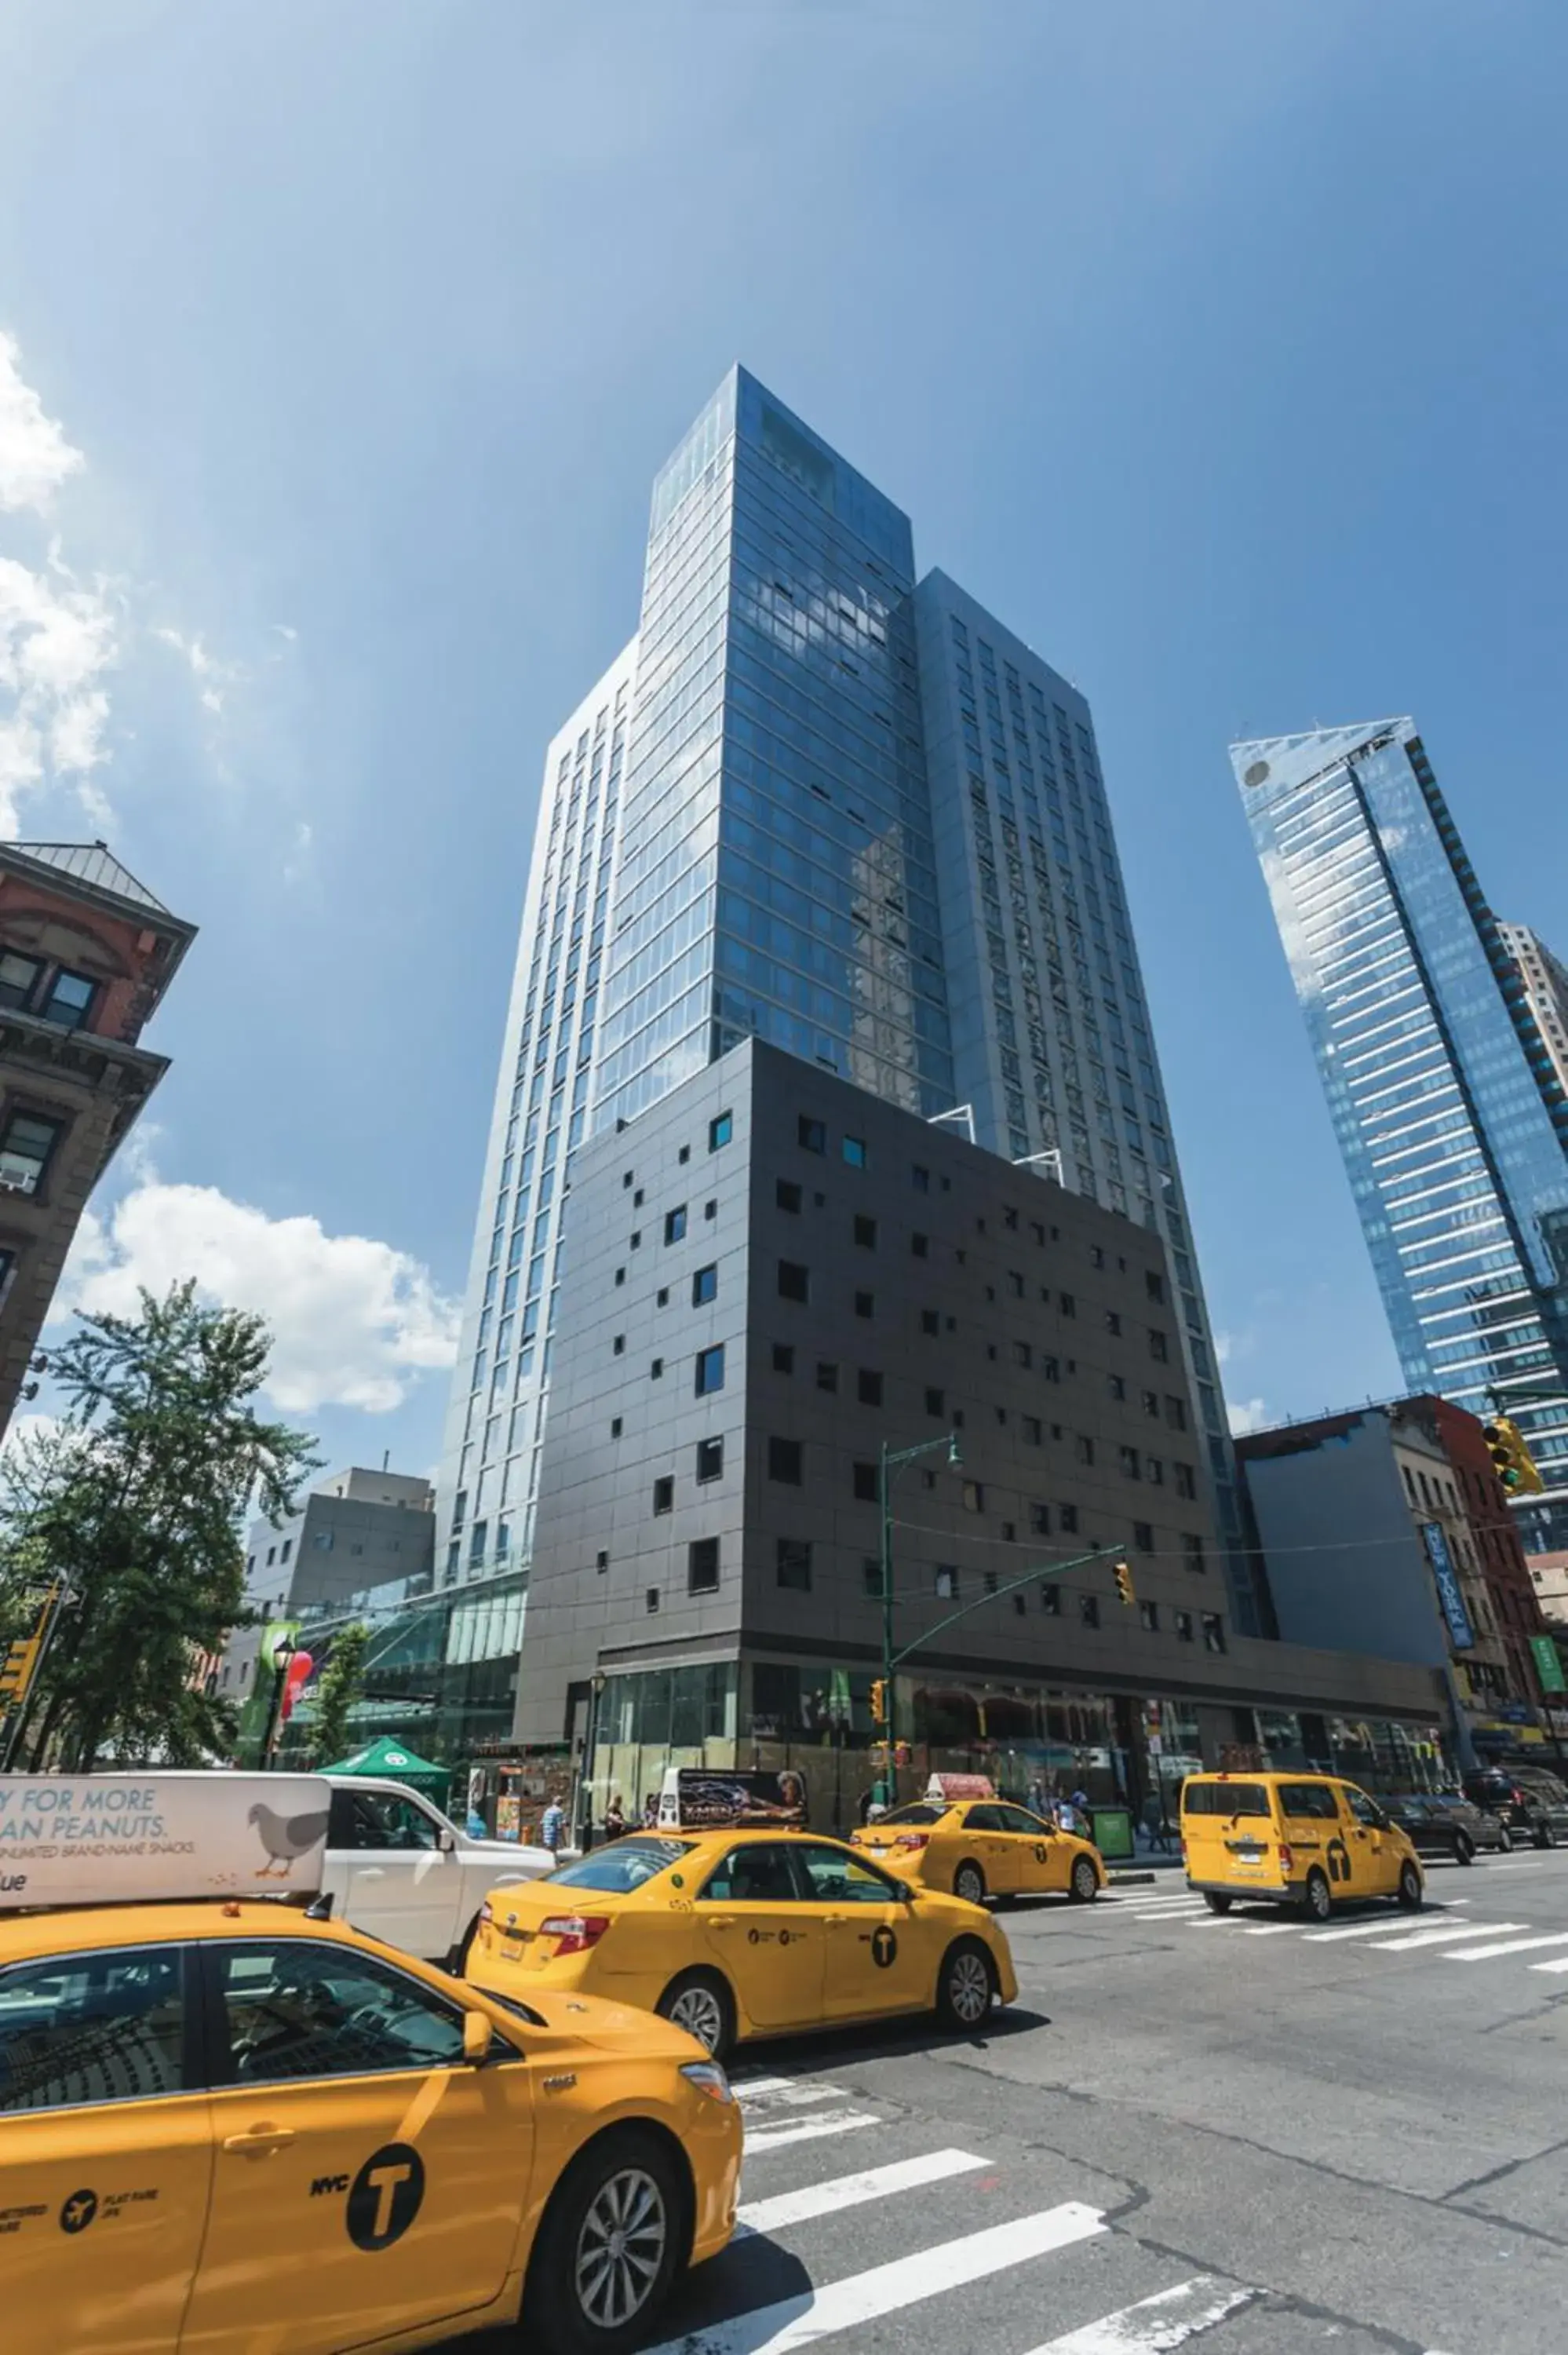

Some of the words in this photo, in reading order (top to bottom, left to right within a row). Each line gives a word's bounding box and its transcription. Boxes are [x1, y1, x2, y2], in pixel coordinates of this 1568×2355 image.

[21, 1789, 74, 1811] FOR
[82, 1789, 155, 1811] MORE
[50, 1816, 168, 1839] PEANUTS.
[877, 1933, 893, 1962] T
[309, 2174, 350, 2196] NYC
[369, 2163, 412, 2236] T
